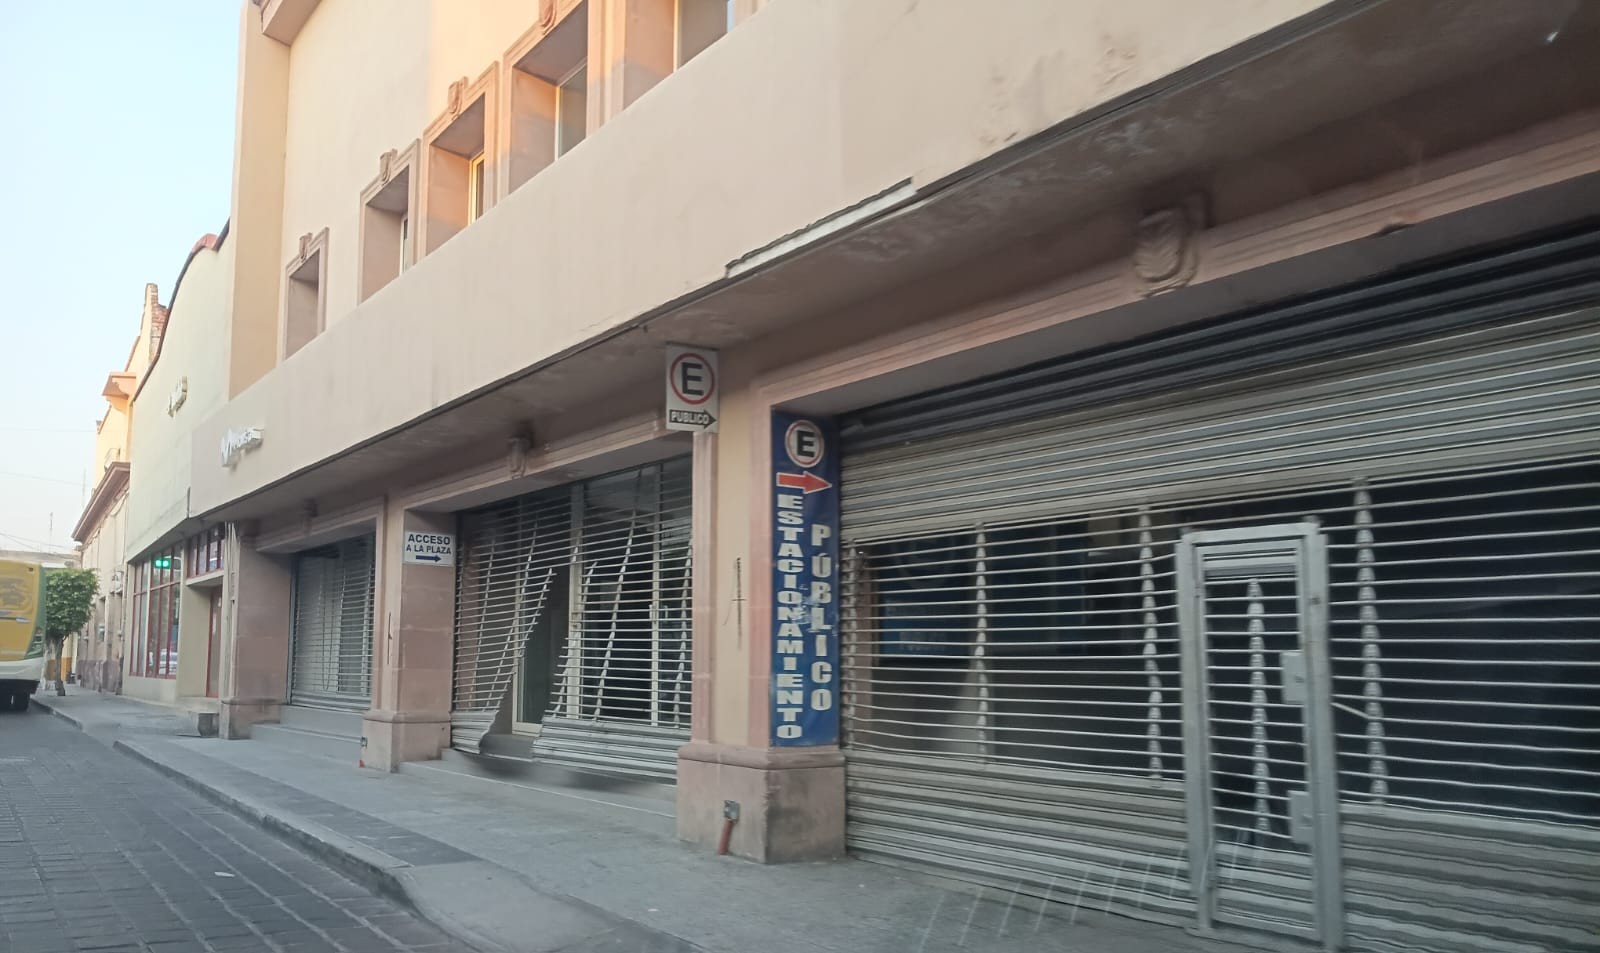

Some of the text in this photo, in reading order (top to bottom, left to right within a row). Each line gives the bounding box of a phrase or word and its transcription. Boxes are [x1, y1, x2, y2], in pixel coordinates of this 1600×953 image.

[682, 362, 704, 396] E
[797, 429, 816, 458] E
[406, 544, 451, 555] A LA PLAZA
[408, 533, 451, 545] ACCESO
[776, 493, 805, 739] ESTACIONAMIENTO
[811, 523, 833, 711] PÚBLICO
